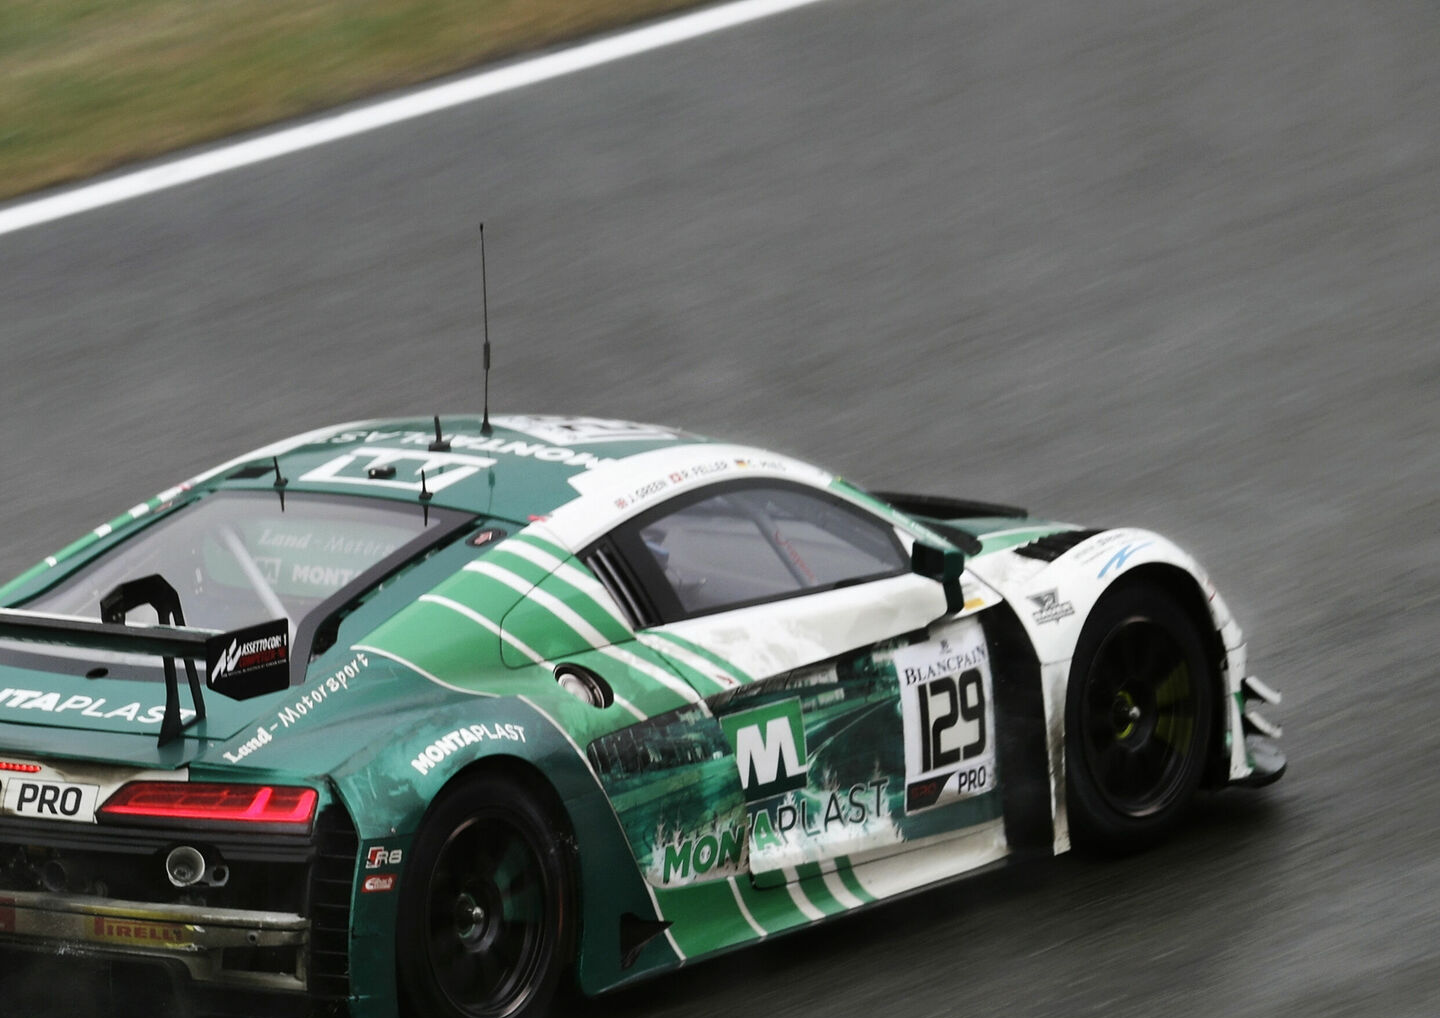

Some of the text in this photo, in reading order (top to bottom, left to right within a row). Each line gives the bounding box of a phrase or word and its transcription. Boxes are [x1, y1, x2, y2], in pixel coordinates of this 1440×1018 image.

[222, 725, 273, 764] Land
[277, 652, 369, 728] Motorsport
[917, 666, 987, 774] 129
[411, 723, 526, 776] MONTAPLAST
[16, 783, 83, 816] PRO
[958, 765, 987, 796] PRO
